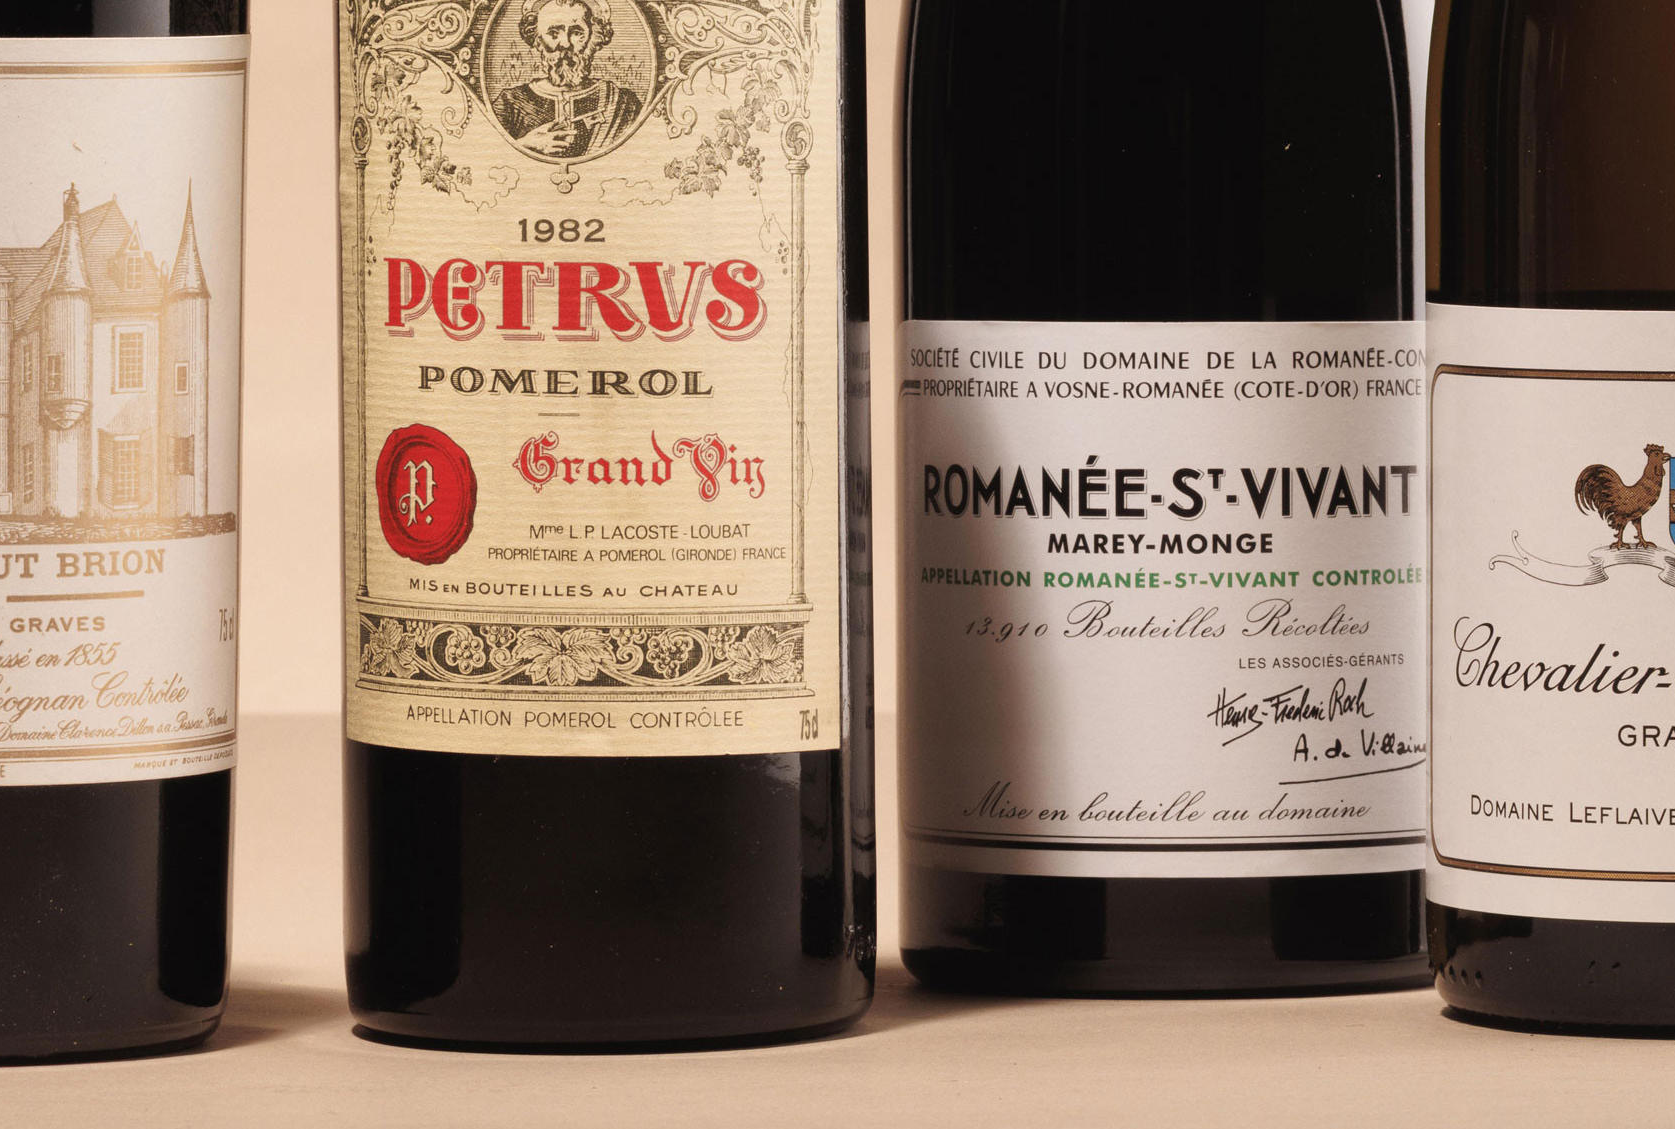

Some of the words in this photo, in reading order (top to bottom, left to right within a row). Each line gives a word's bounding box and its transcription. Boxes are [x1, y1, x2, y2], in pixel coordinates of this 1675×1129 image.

[518, 218, 606, 243] 1982
[910, 348, 959, 368] SOCIÉTÉ
[970, 350, 1024, 369] CIVILE
[1038, 351, 1066, 369] DU
[1083, 351, 1190, 369] DOMAINE
[1207, 351, 1235, 369] DE
[1252, 351, 1276, 369] LA
[418, 365, 714, 398] POMEROL
[922, 378, 1019, 398] PROPRIÉTAIRE
[1026, 381, 1038, 398] A
[1234, 380, 1359, 400] (COTE-D'OR)
[1366, 379, 1423, 397] FRANCE
[512, 429, 674, 494] Grand
[488, 547, 578, 561] PROPRIÉTAIRE
[583, 550, 594, 562] A
[599, 549, 666, 562] POMEROL
[671, 547, 737, 562] (GIRONDE)
[742, 547, 787, 560] FRANCE
[1047, 533, 1273, 554] MAREY-MONGE
[56, 549, 166, 578] BRION
[921, 567, 1031, 587] APPELLATION
[1312, 563, 1422, 587] CONTROLÉE
[409, 578, 439, 592] MIS
[443, 583, 459, 594] EN
[466, 581, 593, 597] BOUTEILLES
[603, 587, 627, 597] AU
[639, 584, 738, 597] CHATEAU
[9, 616, 106, 633] GRAVES
[1063, 599, 1226, 638] Bouteilles
[1242, 598, 1370, 637] Récoltées
[35, 653, 60, 668] en
[63, 642, 121, 667] 1855
[1239, 657, 1266, 669] LES
[1272, 653, 1404, 668] ASSOCIÉS-GÉRANTS
[91, 670, 190, 709] Contrôlée
[406, 704, 512, 726] APPELLATION
[524, 711, 616, 729] POMEROL
[133, 758, 167, 769] MARQUE
[963, 780, 1034, 818] Mise
[1038, 808, 1069, 821] en
[1078, 791, 1206, 822] bouteille
[1212, 808, 1249, 821] au
[1258, 792, 1372, 821] domaine
[1470, 794, 1554, 822] DOMAINE
